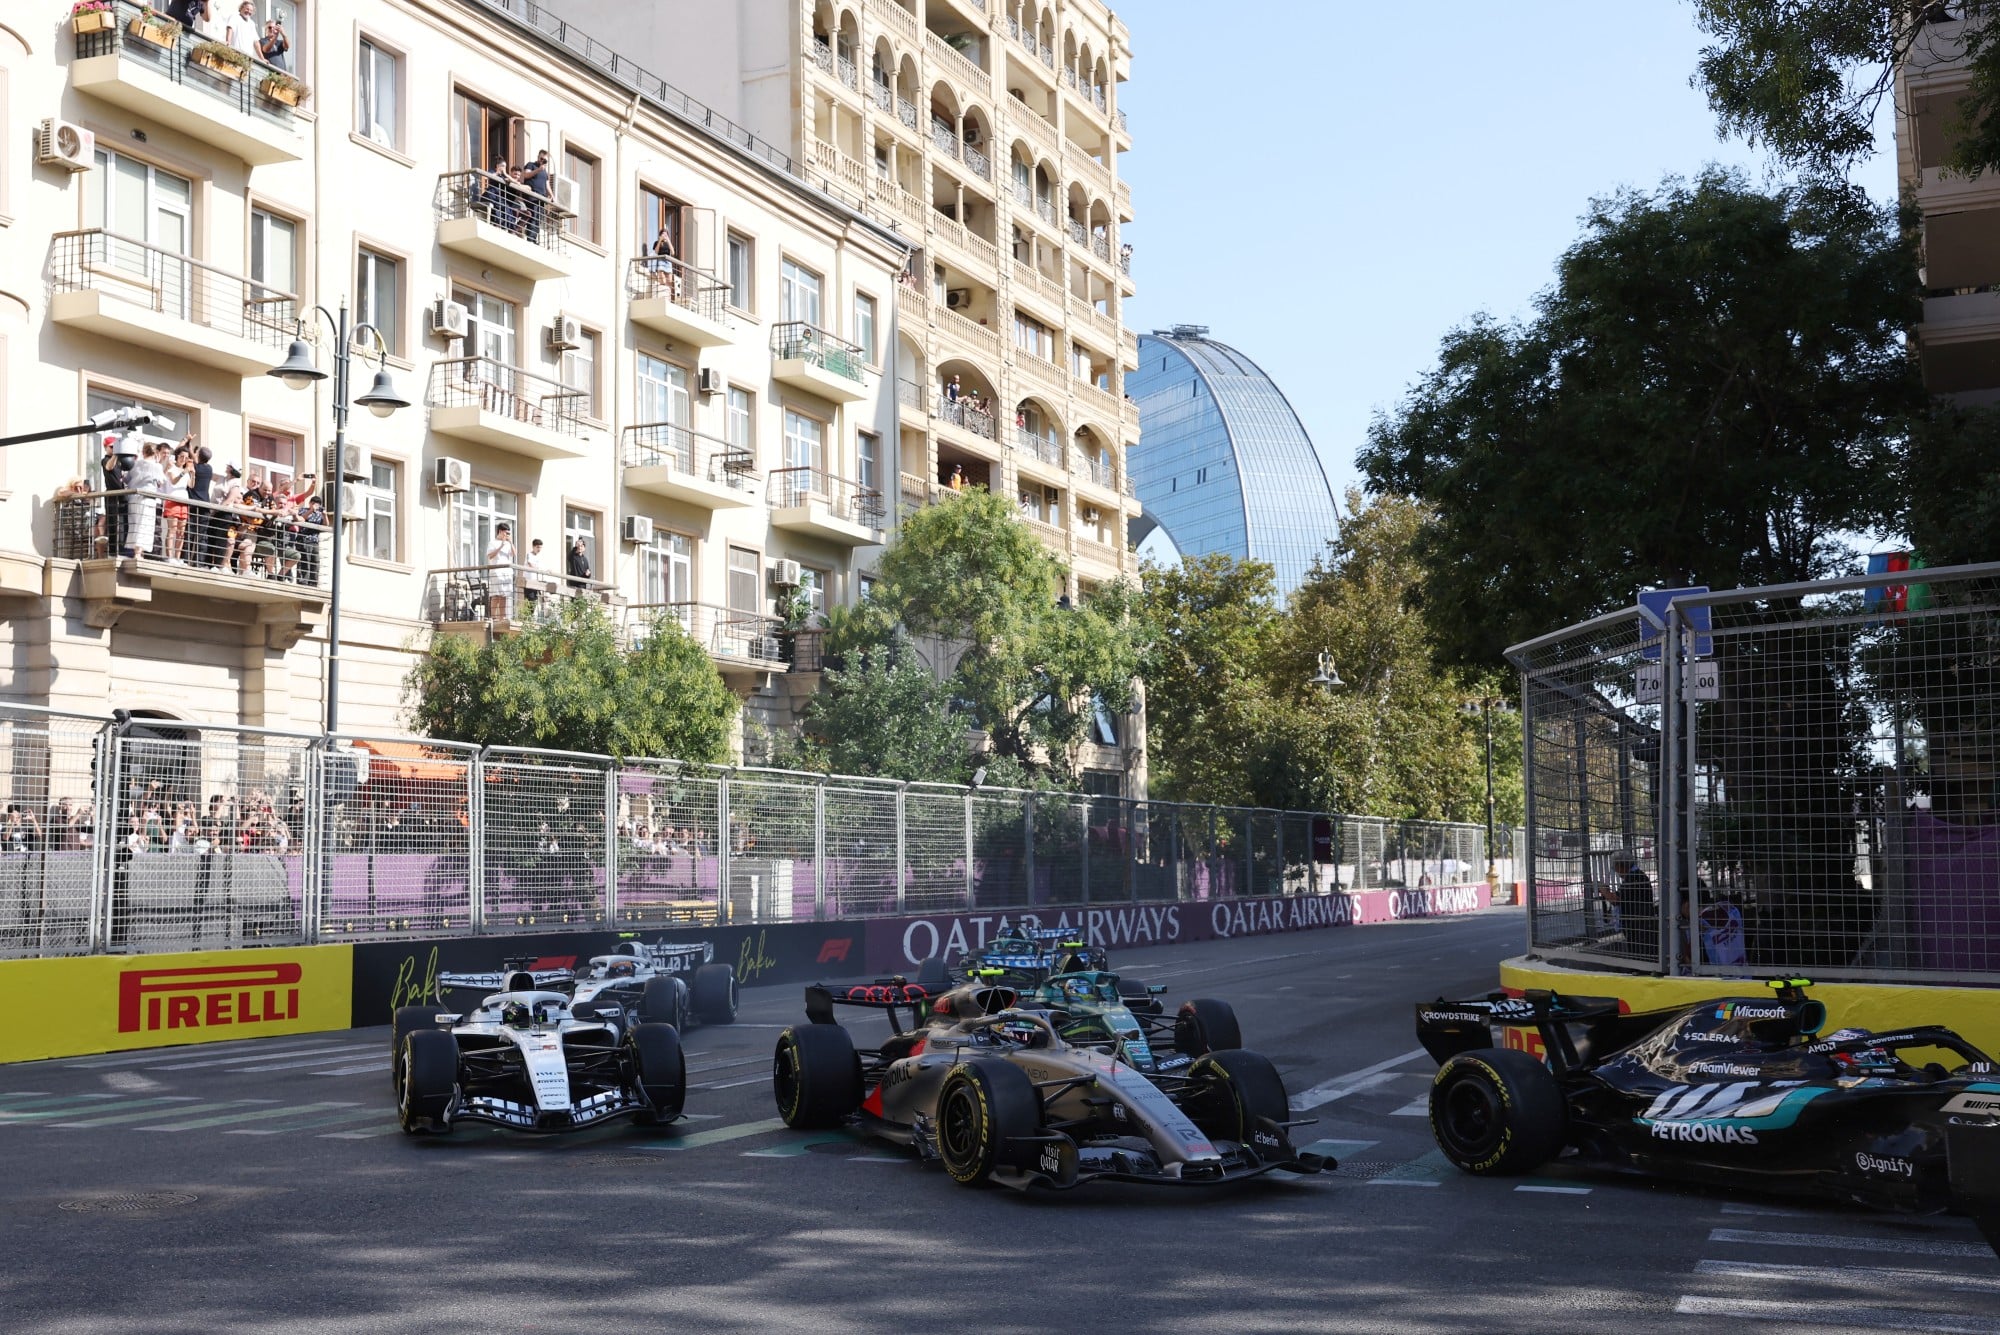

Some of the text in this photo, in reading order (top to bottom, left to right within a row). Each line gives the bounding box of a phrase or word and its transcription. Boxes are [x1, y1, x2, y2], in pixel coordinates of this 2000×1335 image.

[1640, 678, 1662, 691] 7.0
[1388, 886, 1479, 919] QATAR AIRWAYS
[1212, 894, 1362, 938] QATAR AIRWAYS
[738, 928, 777, 984] Baku
[118, 962, 303, 1033] PIRELLI
[1424, 1011, 1480, 1022] CROWDSTRIKE
[1734, 1005, 1786, 1019] Microsoft
[1691, 1032, 1731, 1043] SOLERA
[1808, 1043, 1829, 1054] AMD
[1028, 1068, 1048, 1081] NEXO
[1699, 1061, 1760, 1076] TeamViewer
[1262, 1132, 1279, 1146] berlin
[1651, 1121, 1759, 1145] PETRONAS
[1045, 1143, 1061, 1159] visit
[1040, 1155, 1060, 1173] QATAR
